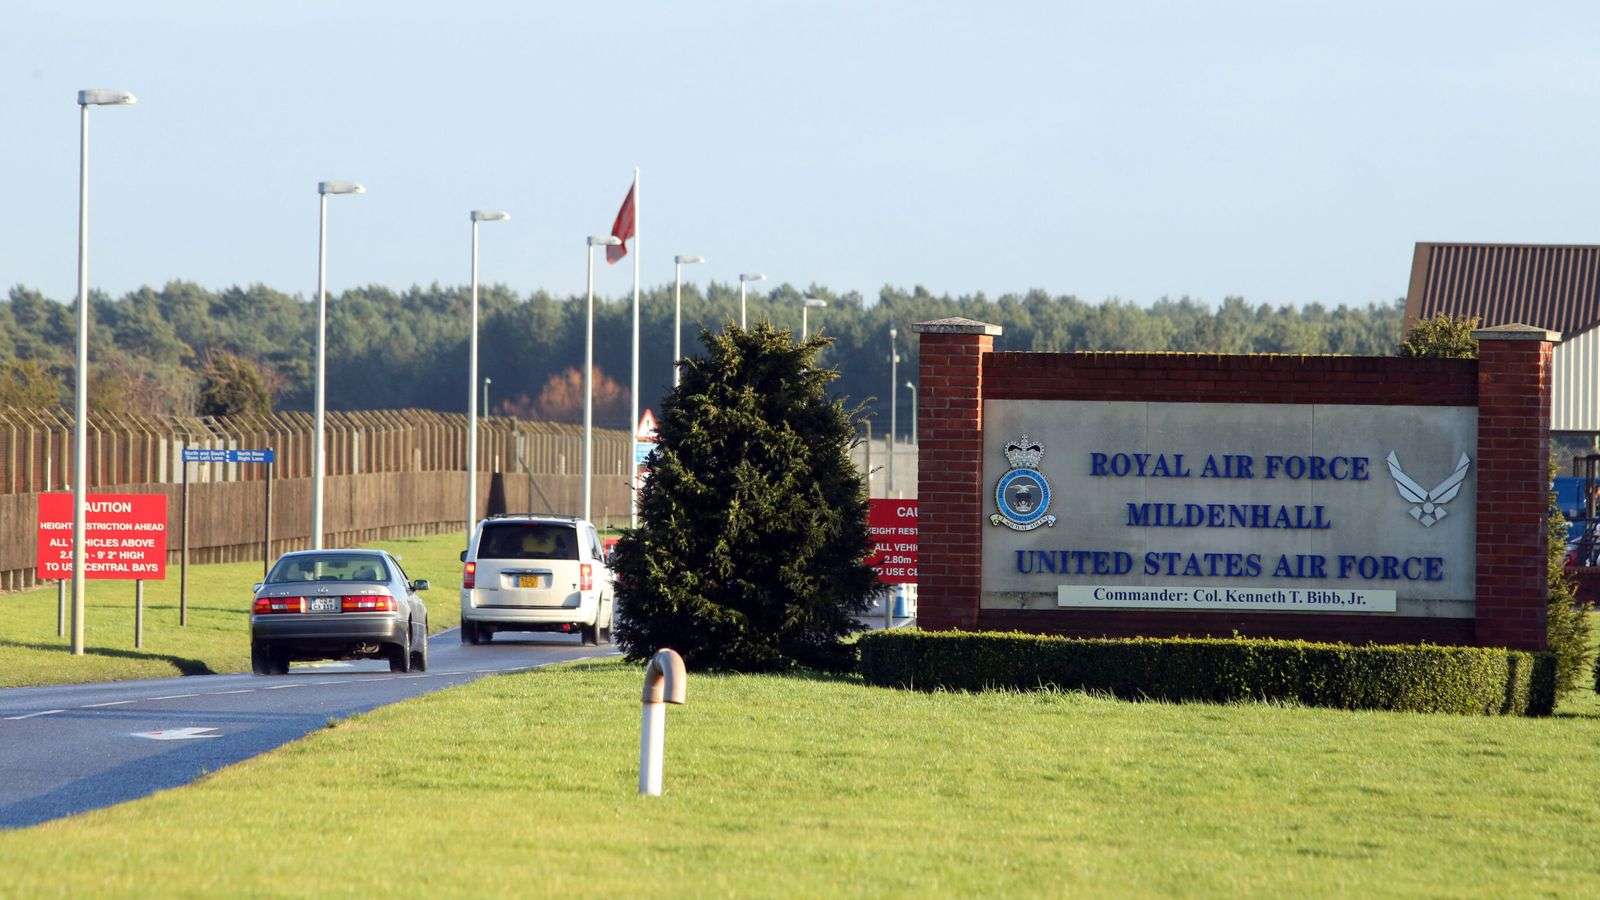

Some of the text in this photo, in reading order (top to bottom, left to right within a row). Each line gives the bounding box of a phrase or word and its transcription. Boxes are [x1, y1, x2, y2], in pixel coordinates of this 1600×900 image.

[1089, 453, 1370, 481] ROYAL AIR FORCE
[83, 502, 132, 513] AUTION
[1126, 502, 1332, 530] MILDENHALL
[40, 522, 164, 531] HEIGHT STRICTION AHEAD
[49, 538, 155, 548] ALL HICLES ABOVE
[875, 543, 892, 551] ALL
[119, 551, 145, 560] HIGH
[884, 555, 912, 564] 2.80m
[45, 562, 158, 572] TO US CENTRAL BAYS
[1015, 550, 1445, 582] UNITED STATES AIR FORCE
[886, 567, 905, 576] USE
[1093, 587, 1367, 605] Commander: Col. Kenneth T. Bibb, Jr.
